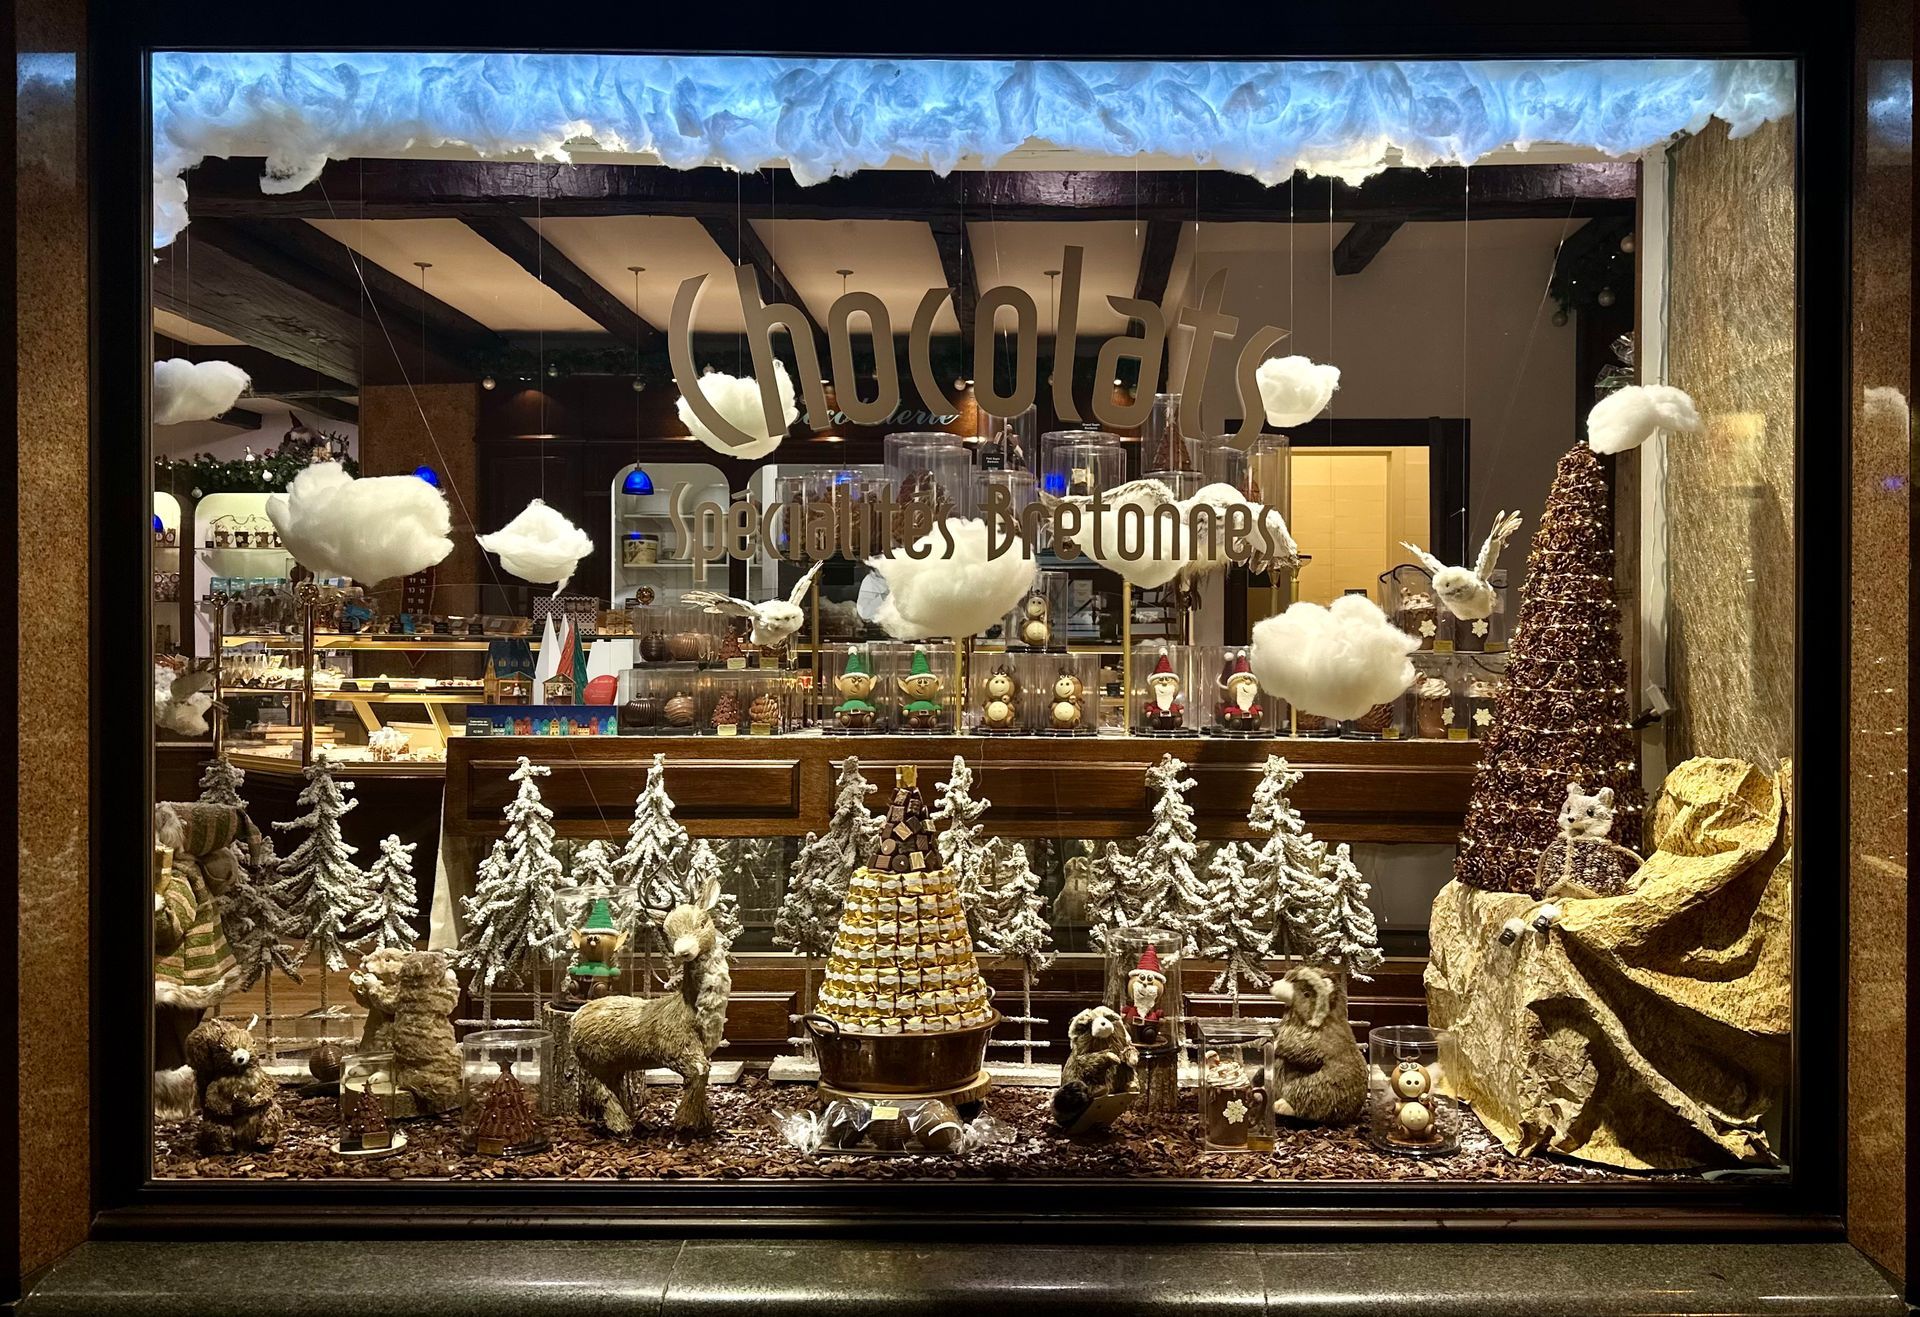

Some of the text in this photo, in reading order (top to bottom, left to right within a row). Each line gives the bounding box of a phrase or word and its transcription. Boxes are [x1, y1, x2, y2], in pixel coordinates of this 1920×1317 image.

[668, 245, 1292, 451] Chocolats
[669, 481, 1278, 581] Spécialités Bretonnes
